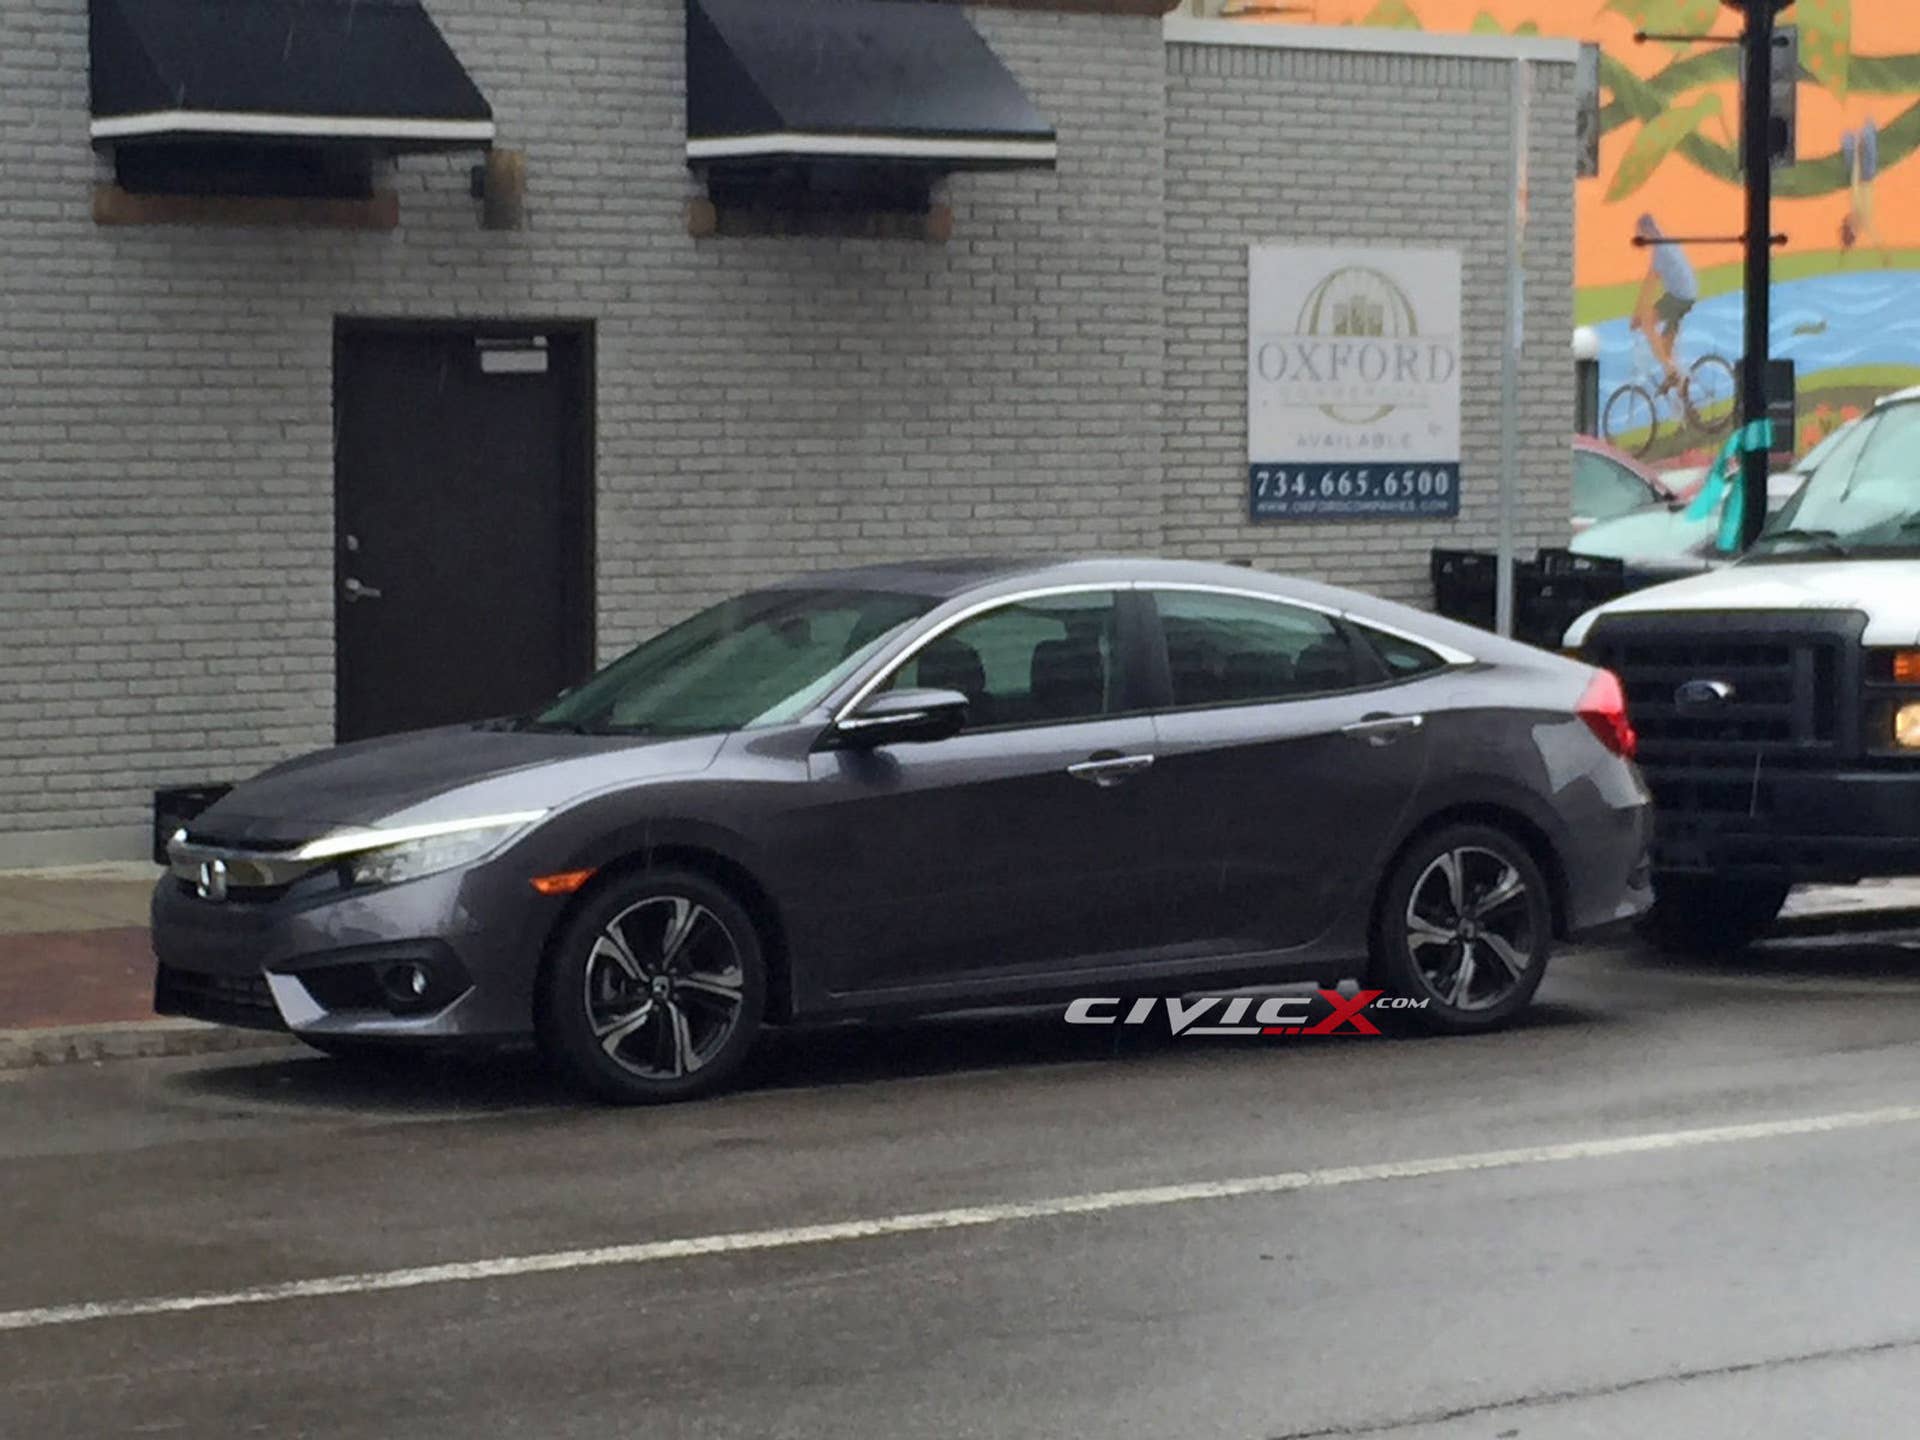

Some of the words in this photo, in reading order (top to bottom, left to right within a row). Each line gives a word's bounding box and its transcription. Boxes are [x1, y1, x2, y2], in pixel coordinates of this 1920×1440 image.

[1258, 342, 1455, 384] OXFORD
[1297, 432, 1413, 449] AVAILABLE
[1256, 470, 1449, 498] 734.665.6500
